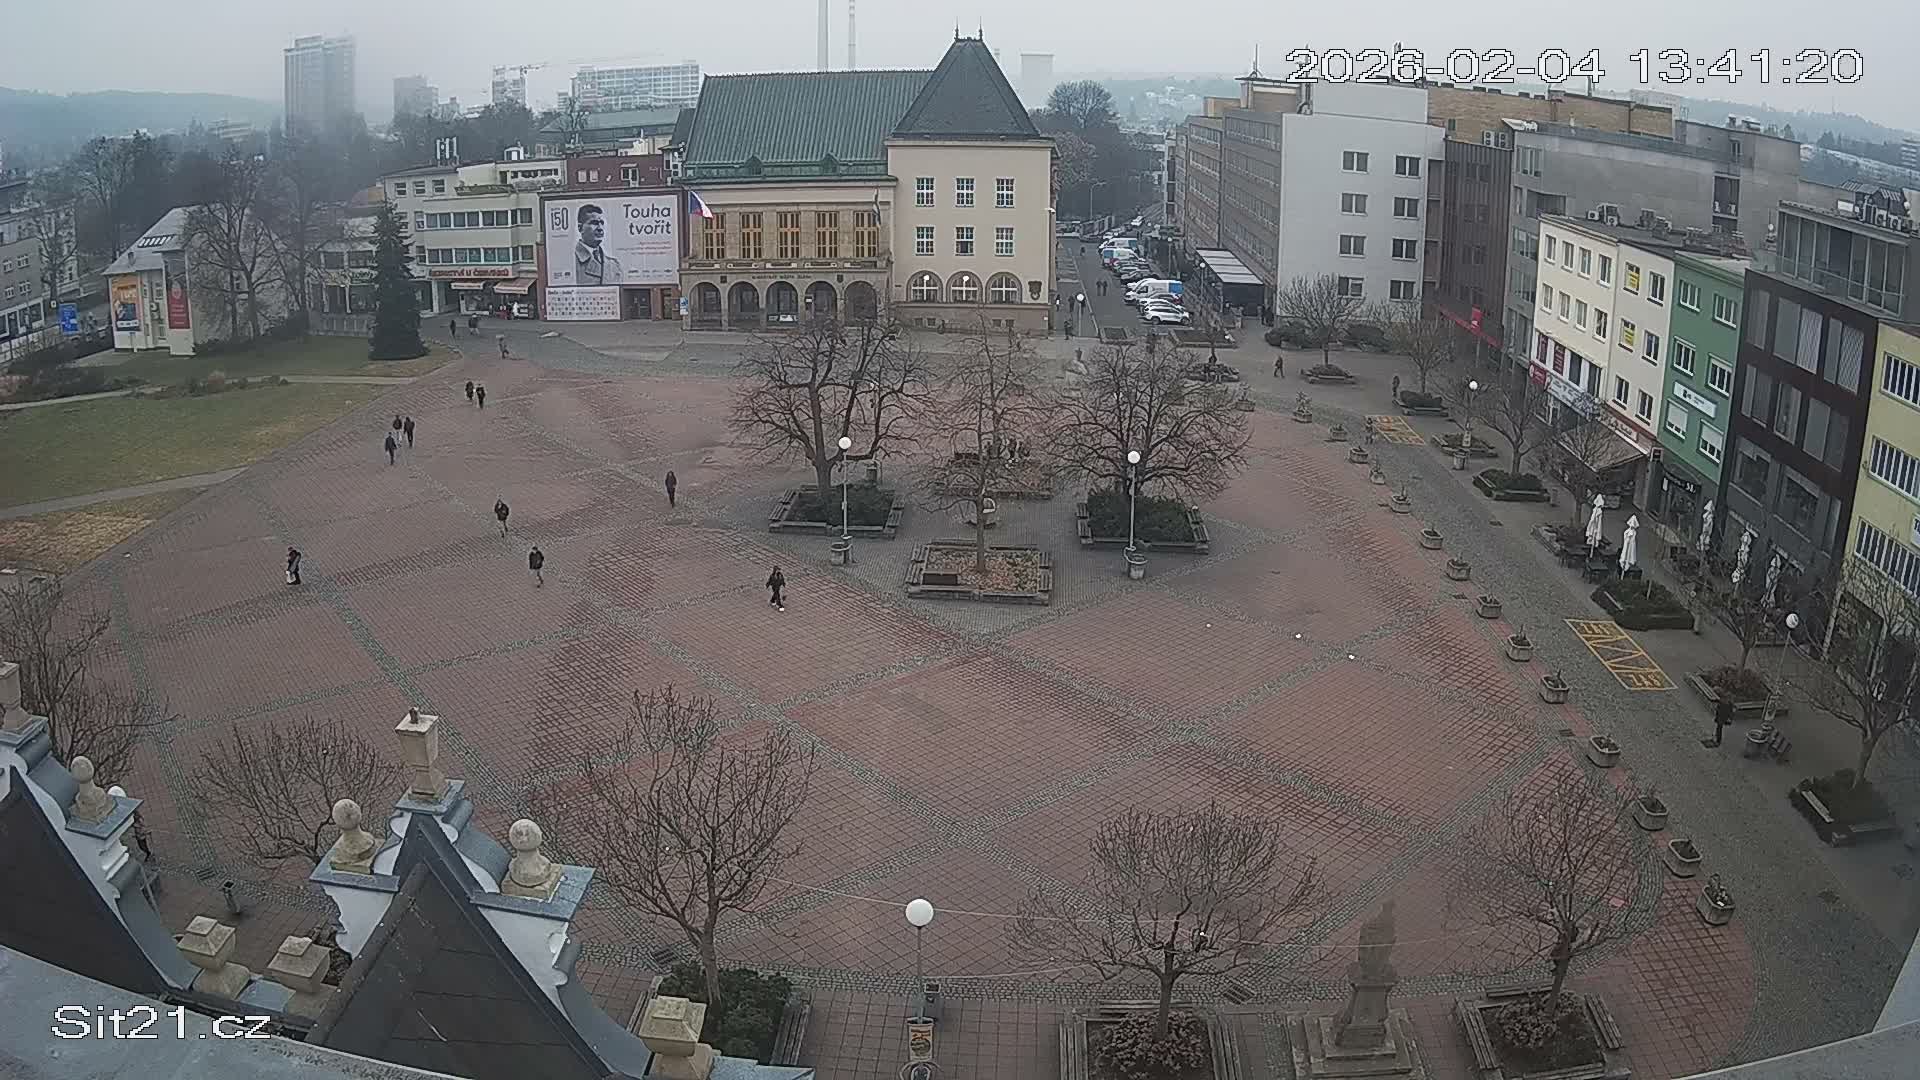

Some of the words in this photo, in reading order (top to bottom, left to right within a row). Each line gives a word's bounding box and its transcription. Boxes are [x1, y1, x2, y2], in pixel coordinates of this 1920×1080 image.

[550, 207, 569, 231] 150
[623, 203, 671, 219] Touha
[629, 220, 672, 236] tvořit
